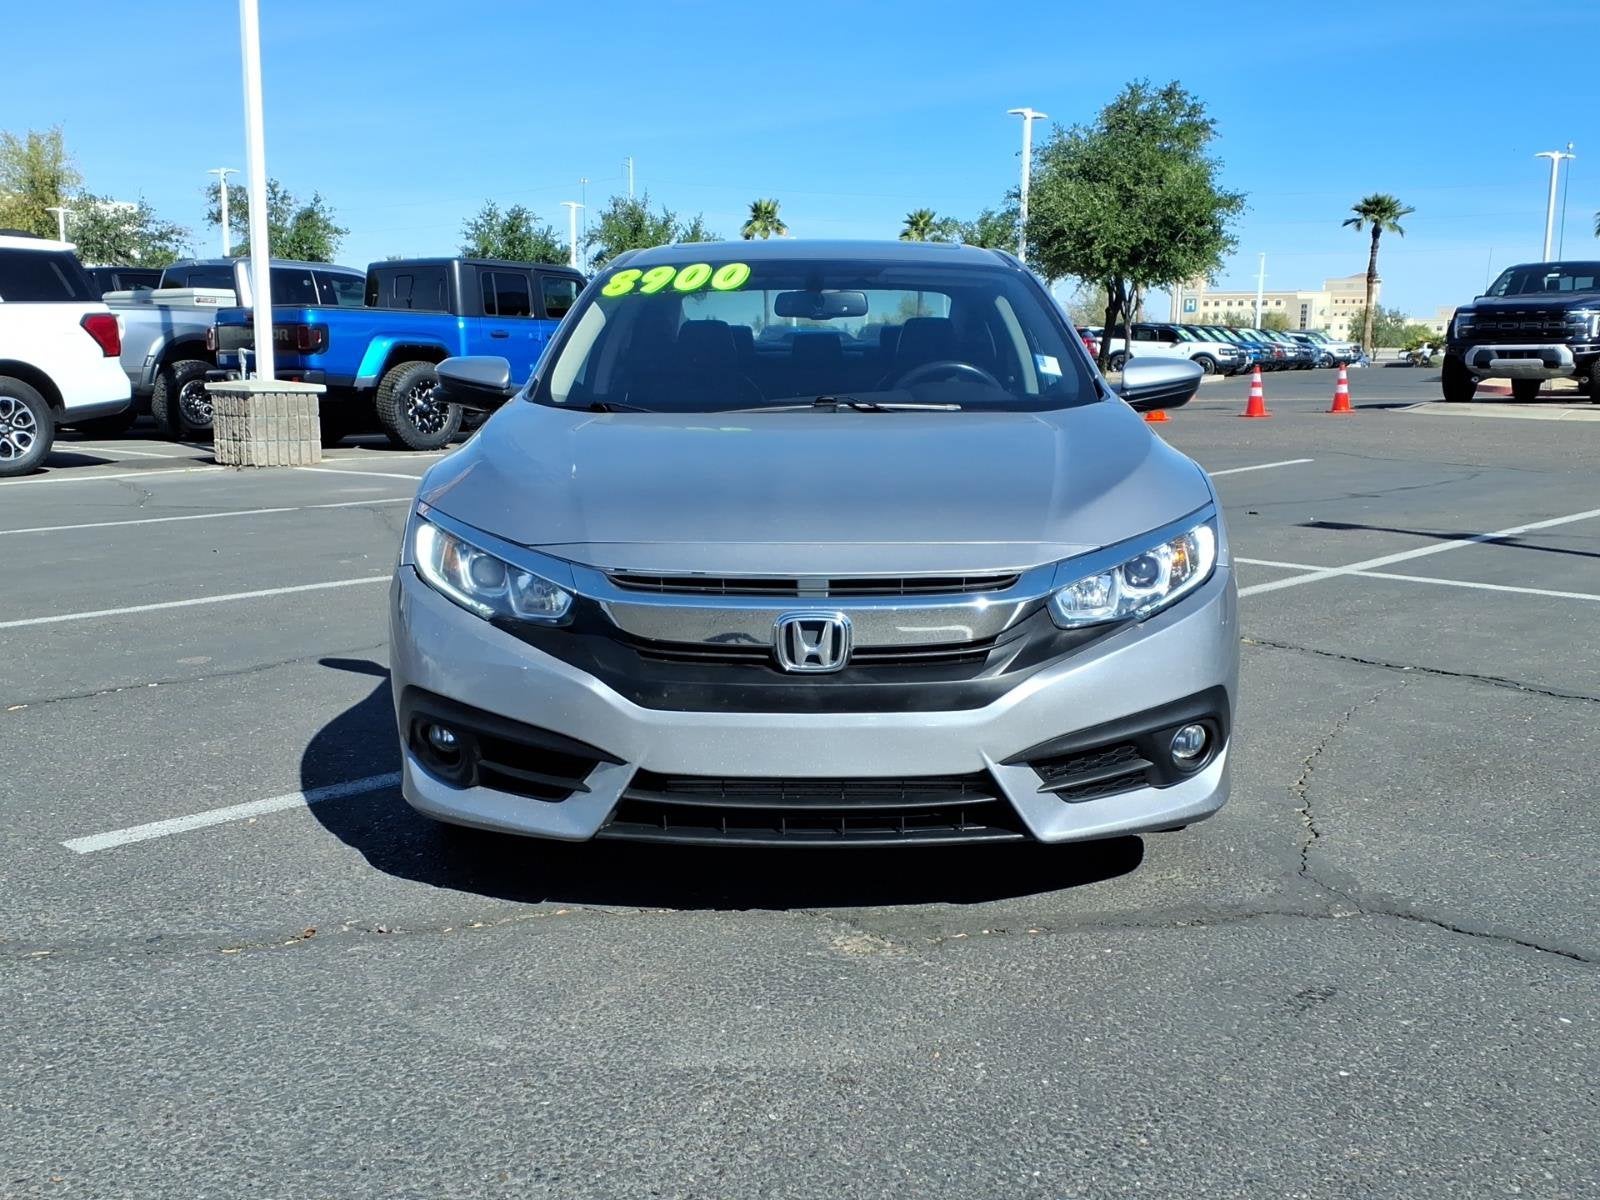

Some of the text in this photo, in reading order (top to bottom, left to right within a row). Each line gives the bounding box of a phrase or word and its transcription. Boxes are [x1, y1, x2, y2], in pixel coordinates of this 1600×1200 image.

[601, 262, 750, 297] 8900
[1186, 299, 1196, 311] H
[1476, 321, 1566, 330] FORD
